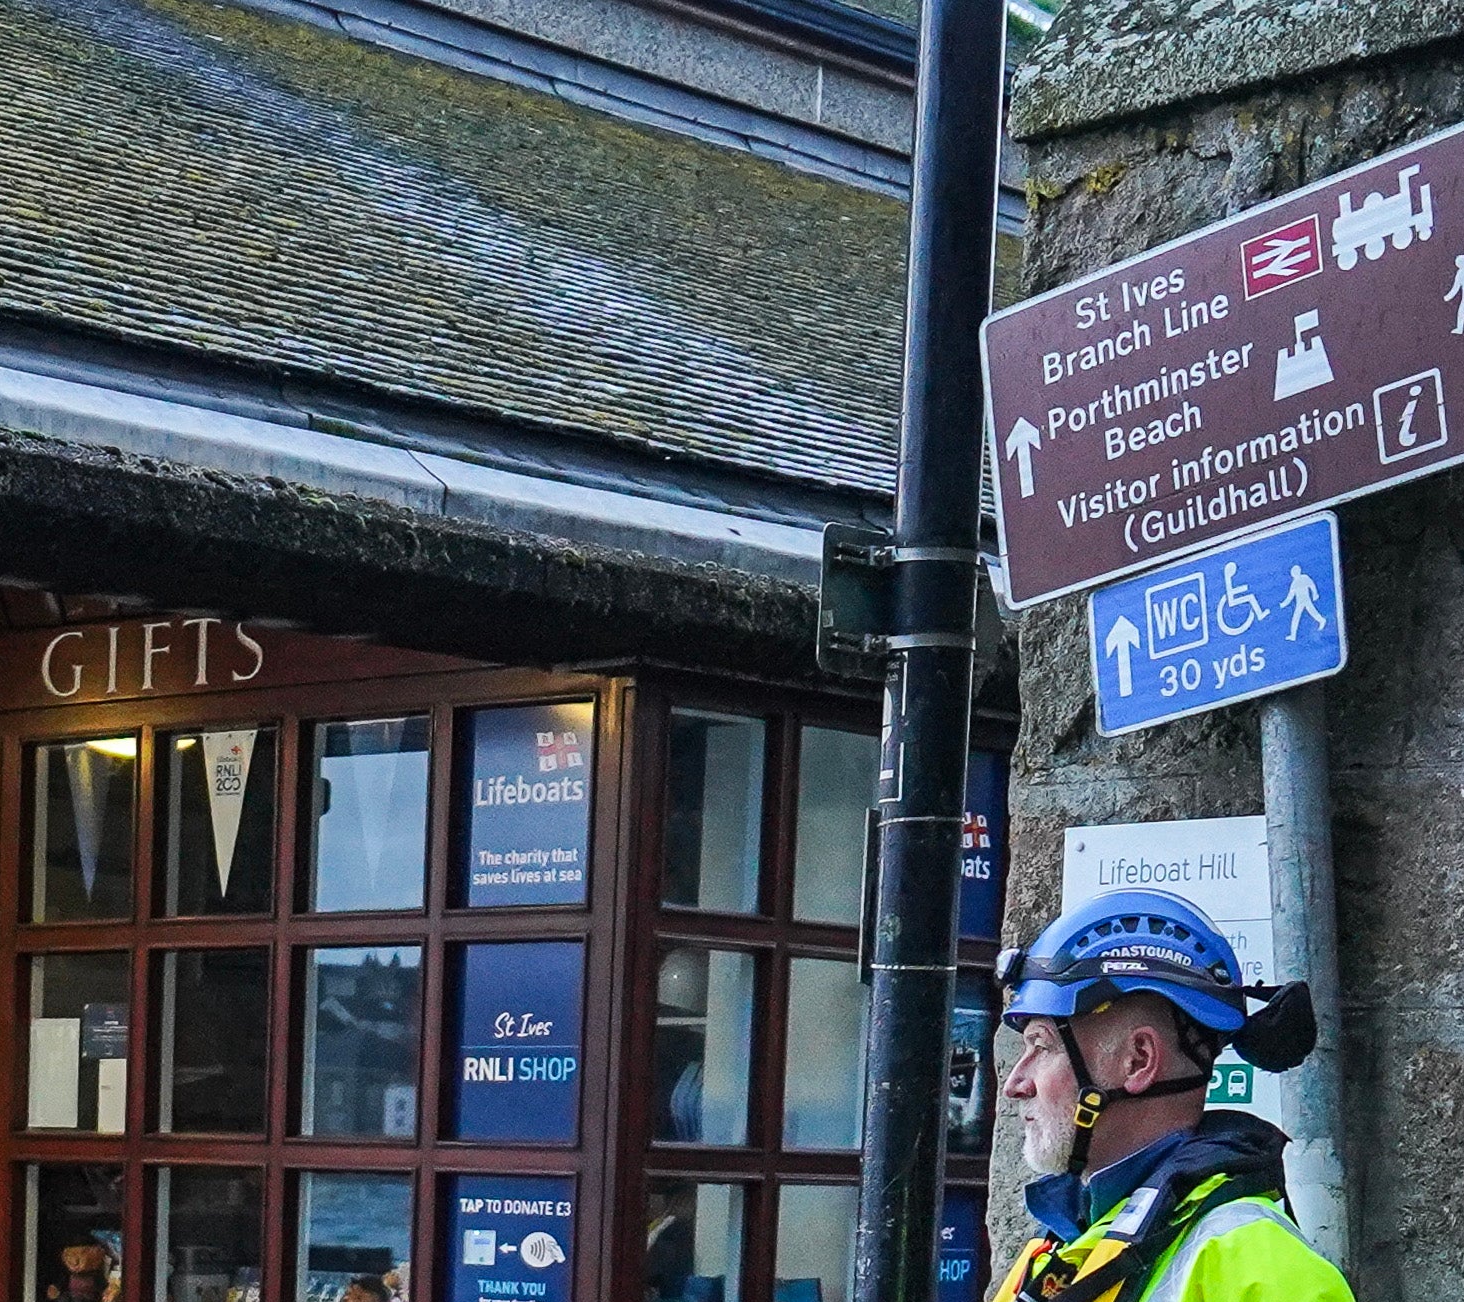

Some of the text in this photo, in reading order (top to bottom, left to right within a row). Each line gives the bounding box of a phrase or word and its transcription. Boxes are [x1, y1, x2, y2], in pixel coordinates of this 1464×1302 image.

[1074, 267, 1185, 330] St Ives
[1041, 295, 1229, 385] Branch Line
[1046, 343, 1254, 440] Porthminster
[1105, 405, 1202, 460] Beach
[1056, 403, 1366, 529] Visitor information
[1123, 457, 1310, 552] (Guildhall)
[1152, 592, 1201, 640] WC
[40, 617, 264, 698] GIFTS
[1159, 644, 1266, 697] 30 yds
[474, 775, 584, 806] Lifeboats
[473, 868, 583, 885] saves lives at sea
[478, 848, 579, 868] The charity that
[1098, 851, 1238, 886] Lifeboat Hill
[493, 1012, 553, 1038] St Ives
[463, 1057, 577, 1082] RNLI SHOP
[459, 1198, 572, 1217] TAP TO DONATE £3
[478, 1279, 546, 1296] THANK YOU
[938, 1258, 971, 1282] HOP
